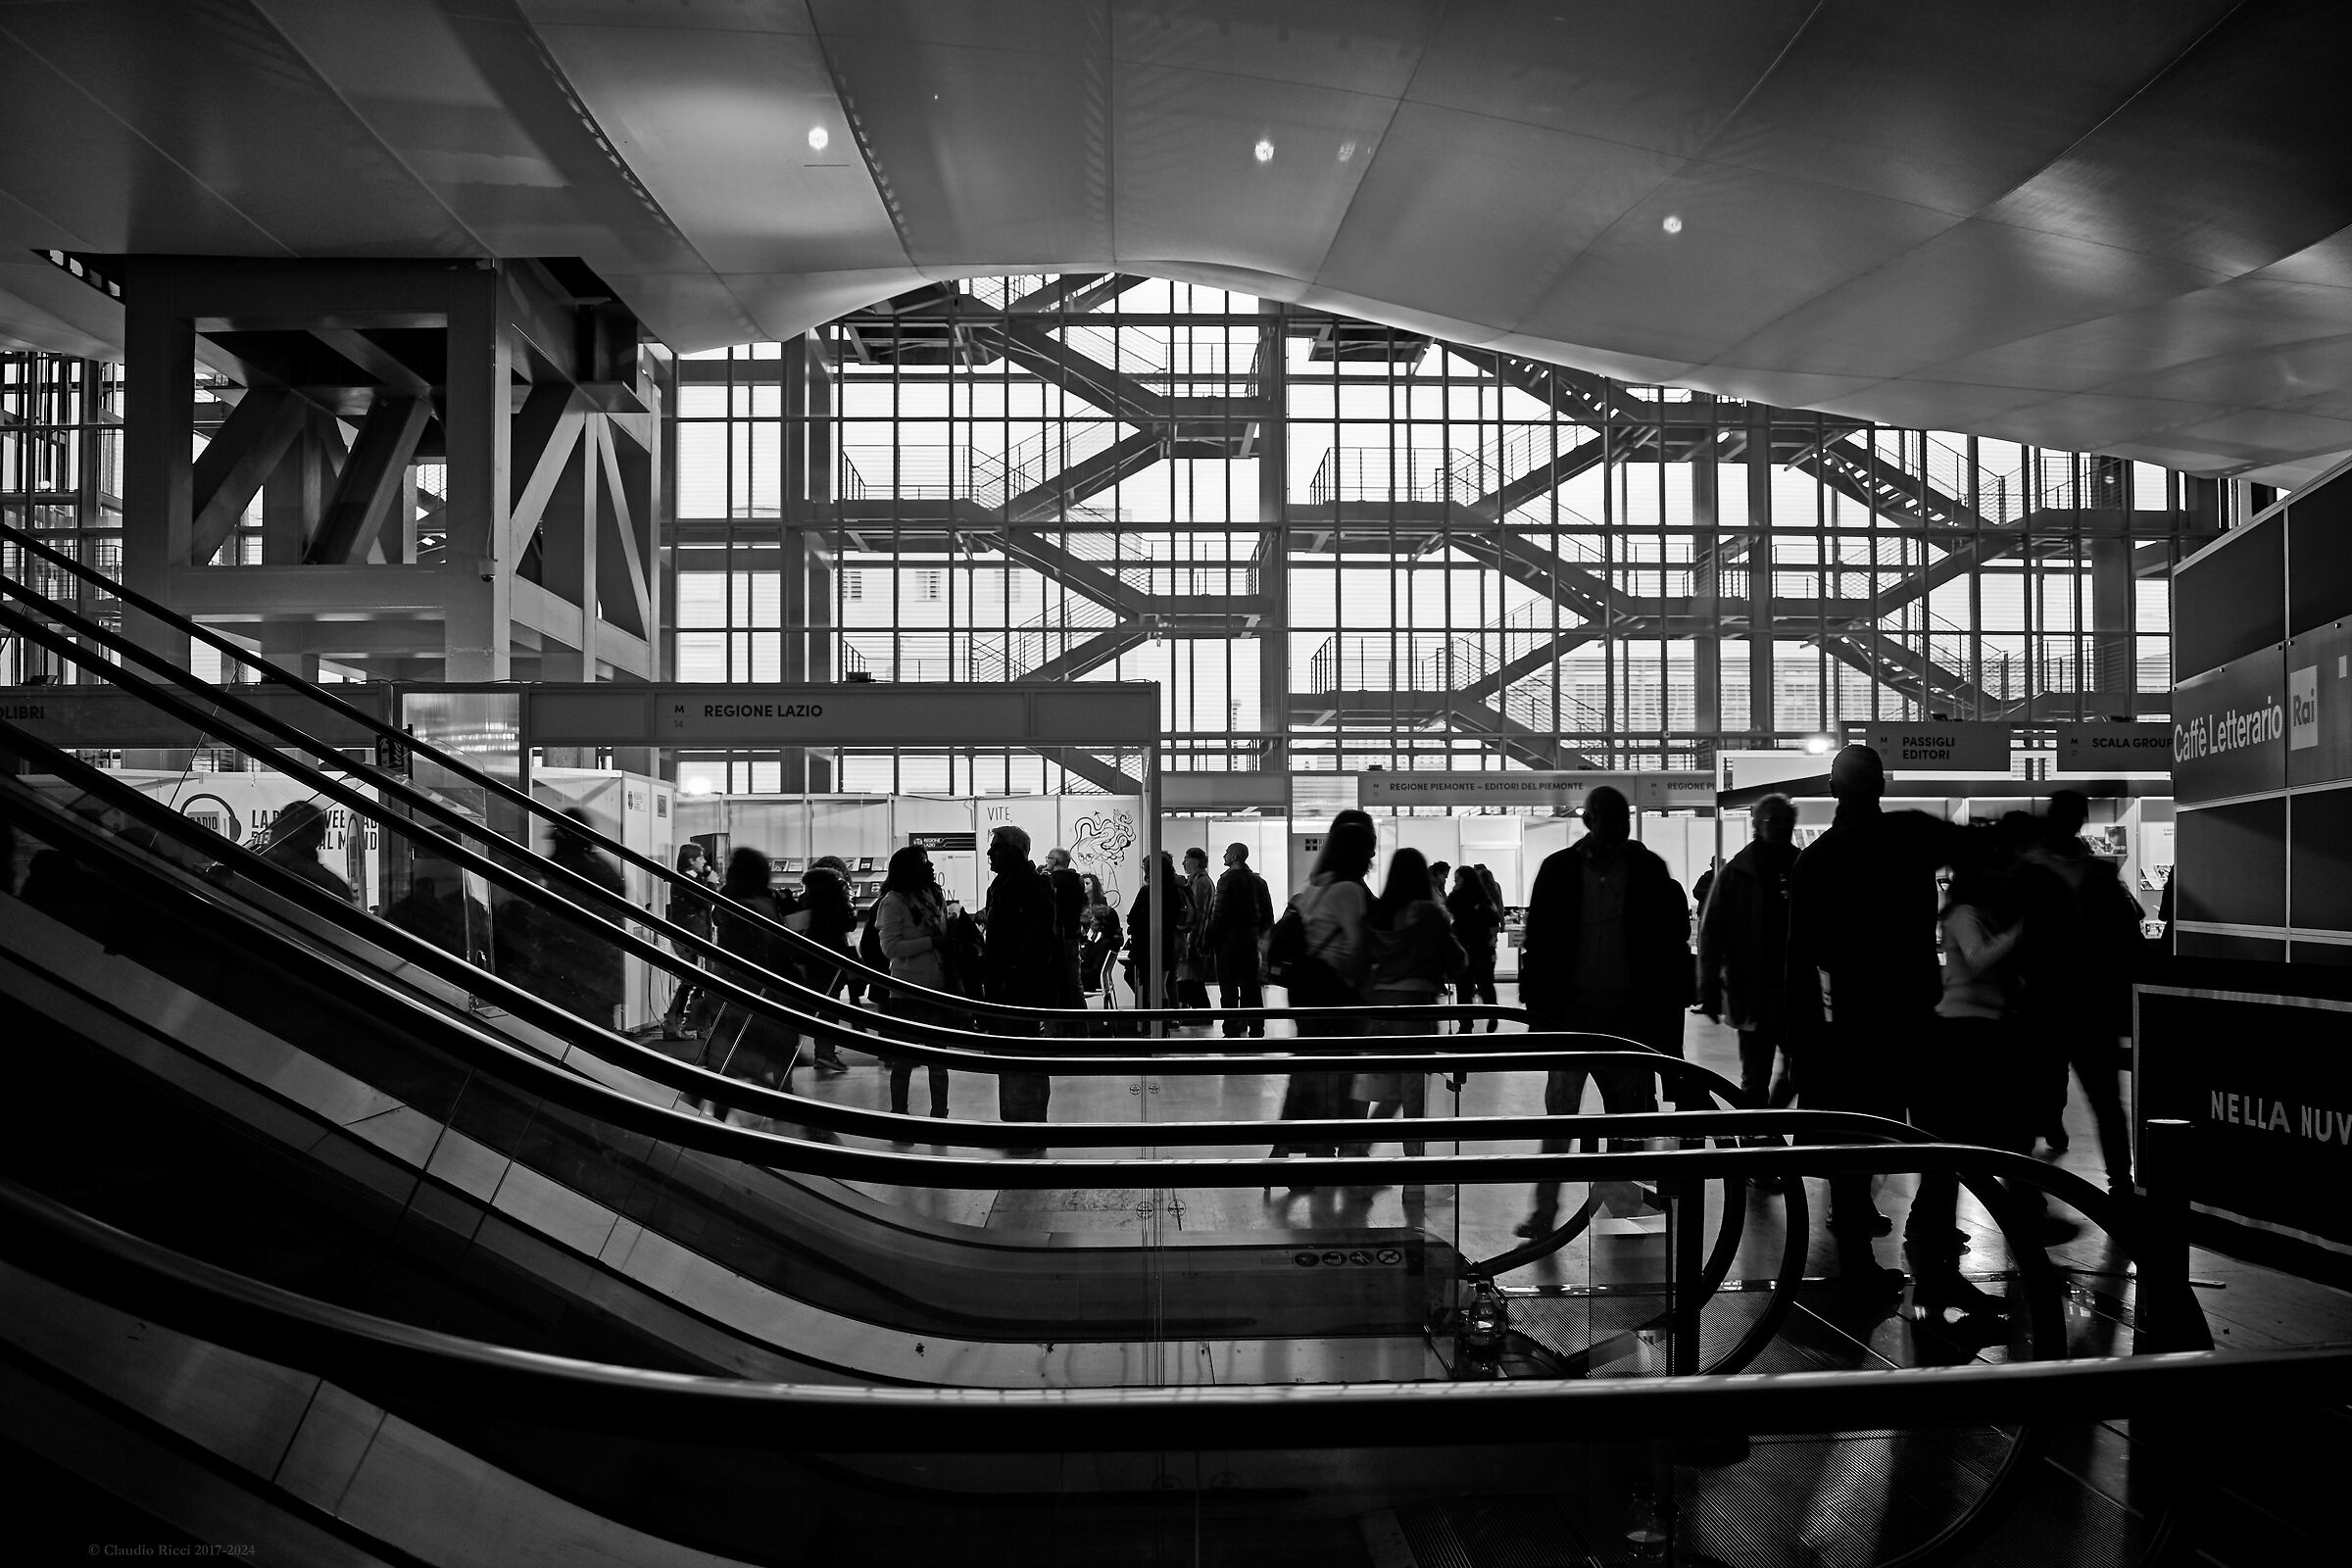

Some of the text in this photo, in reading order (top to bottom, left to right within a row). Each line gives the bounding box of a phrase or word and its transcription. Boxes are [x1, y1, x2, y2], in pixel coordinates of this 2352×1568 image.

[674, 705, 685, 713] M
[704, 705, 823, 717] REGIONE LAZIO
[2293, 688, 2315, 727] Rai
[2174, 695, 2283, 762] Caffè Letterario
[1902, 737, 1955, 747] PASSIGLI
[2092, 738, 2174, 748] SCALA GROUP
[1902, 750, 1950, 760] EDITORI
[1667, 782, 1705, 791] REGIONE
[190, 816, 218, 829] ADIO
[2210, 1089, 2292, 1134] NELLA
